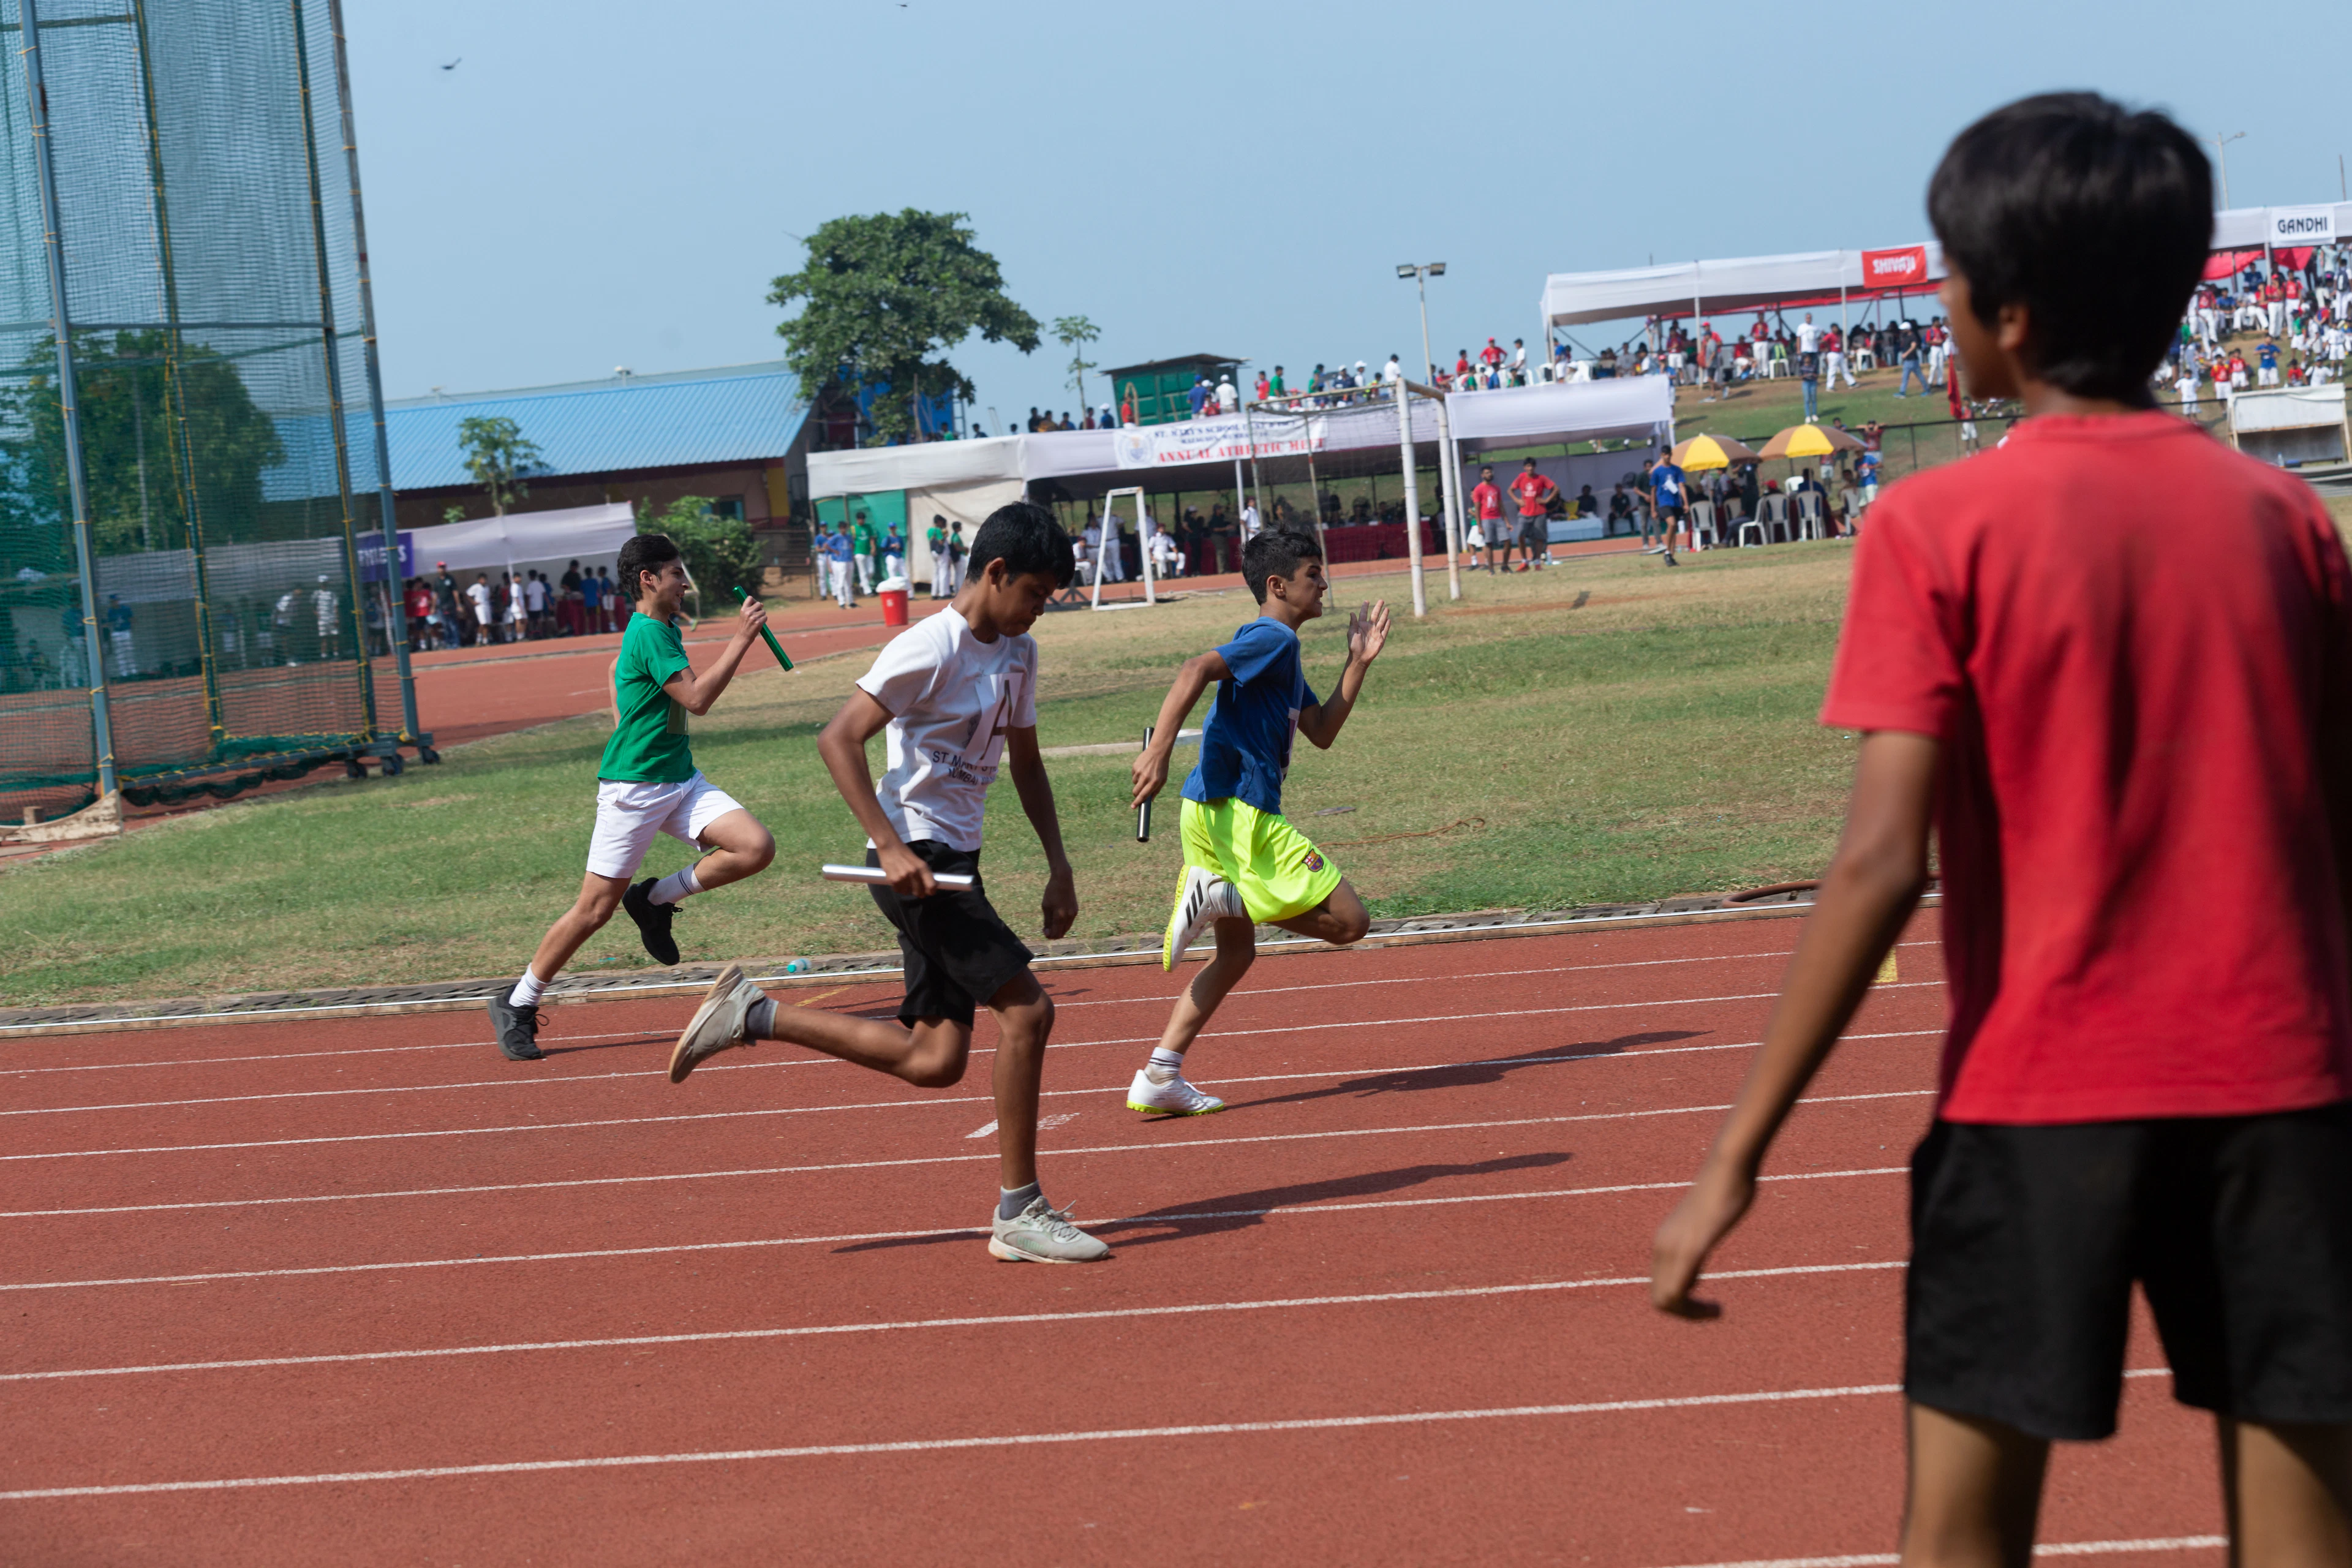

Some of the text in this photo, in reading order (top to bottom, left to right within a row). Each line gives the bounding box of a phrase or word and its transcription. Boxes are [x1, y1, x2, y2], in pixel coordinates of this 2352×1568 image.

[2278, 217, 2328, 234] GANDHI
[1872, 255, 1916, 274] SHIVAJI
[1206, 423, 1238, 433] SCHOOL
[1158, 437, 1324, 462] ANNUAL ATHLETIC MEET
[932, 751, 949, 763] ST
[951, 755, 987, 772] MARS
